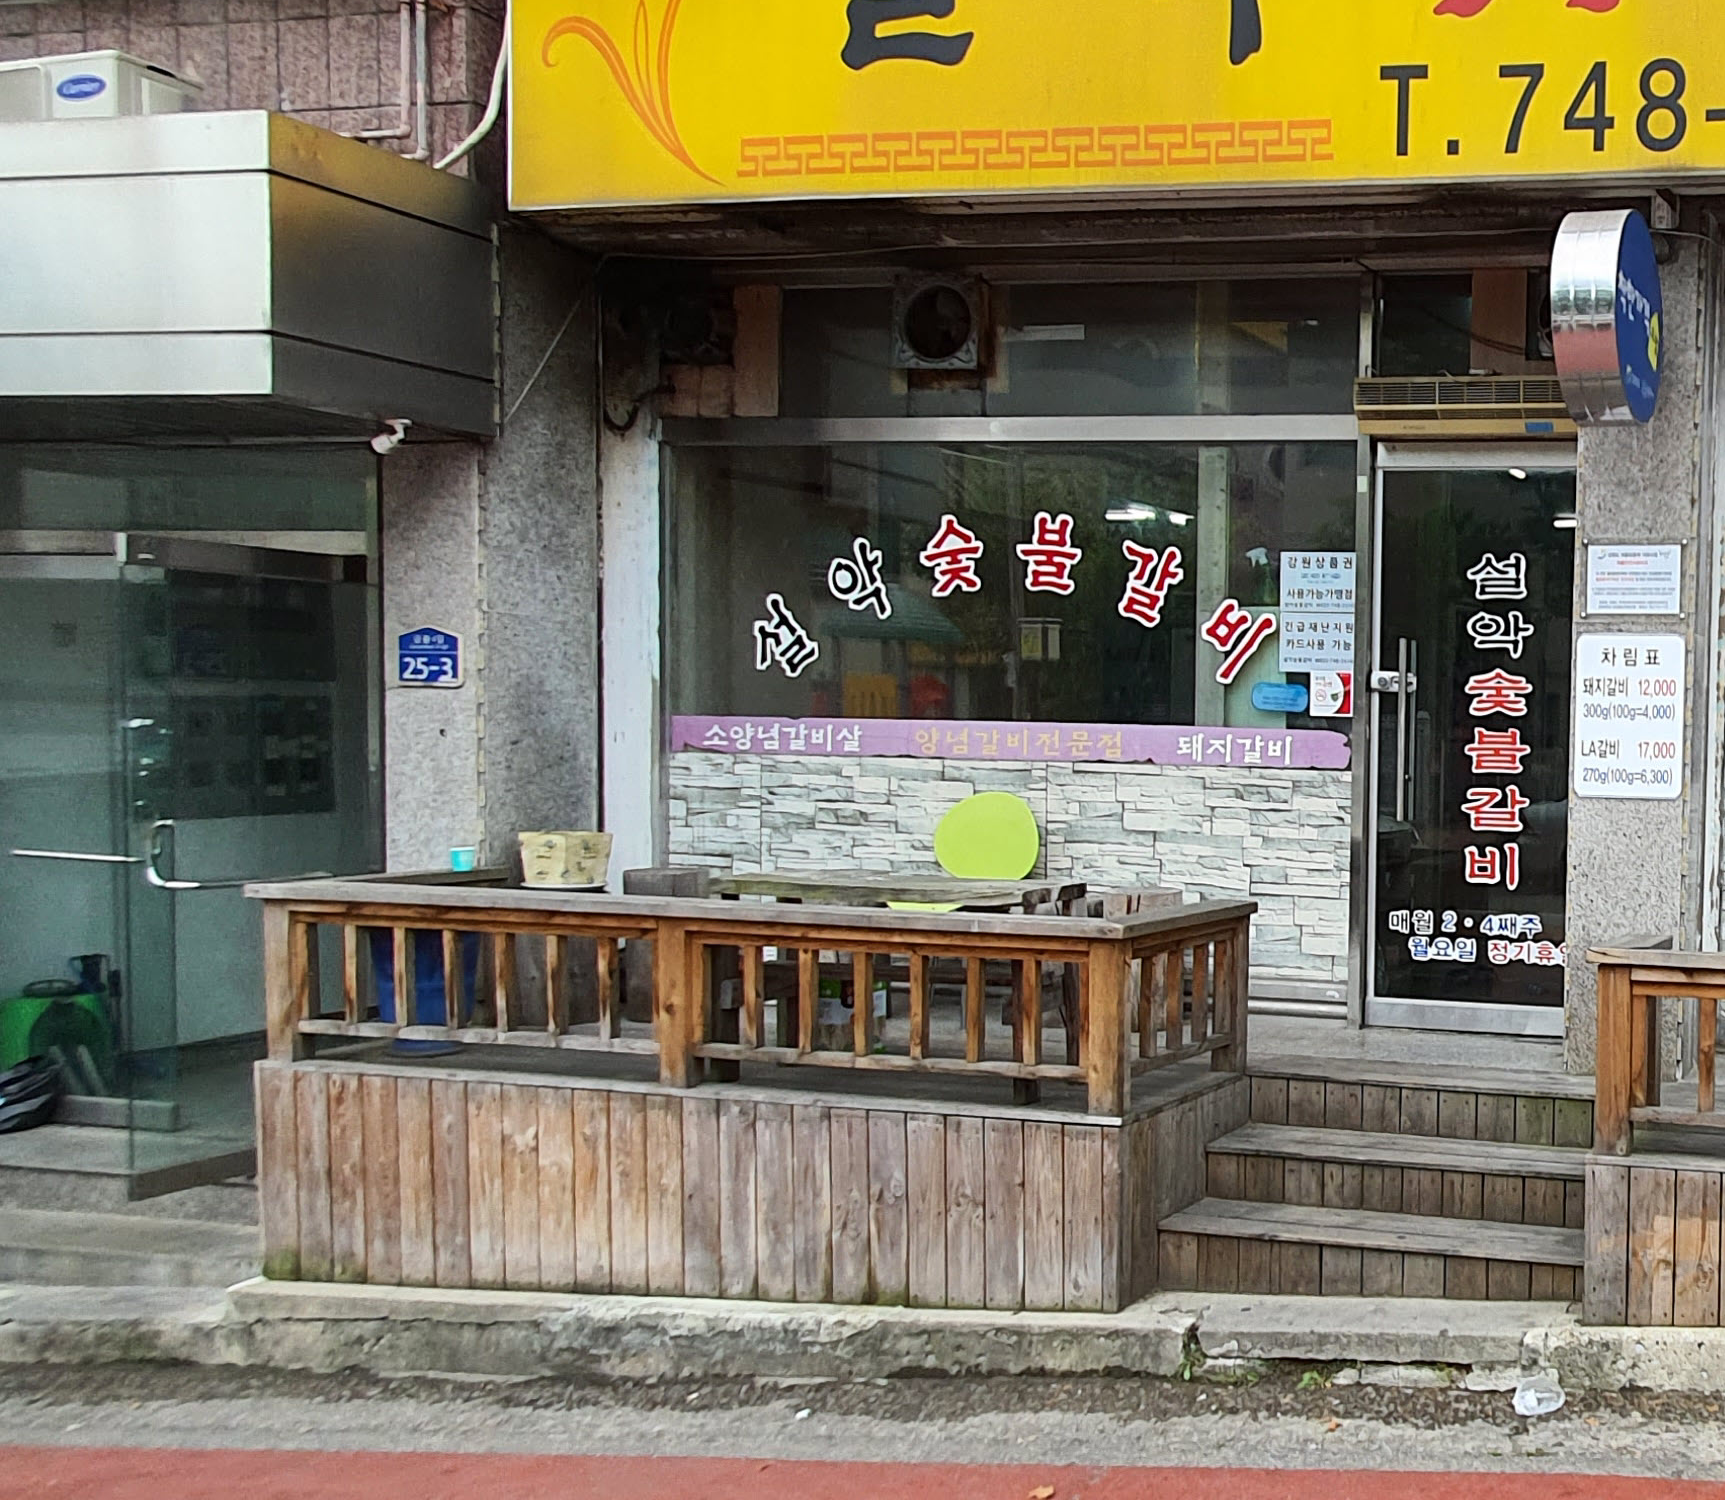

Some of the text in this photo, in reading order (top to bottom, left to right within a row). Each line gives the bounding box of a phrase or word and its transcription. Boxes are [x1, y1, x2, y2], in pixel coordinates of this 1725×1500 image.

[1600, 647, 1661, 668] 차림표
[402, 656, 454, 681] 25-3
[1582, 677, 1677, 697] 돼지갈비 12,000
[1583, 702, 1676, 721] 300g(100g=4,000)
[702, 721, 1294, 766] 소양념갈비살 양념갈비전문점 돼지갈비
[1581, 739, 1676, 760] LA갈비 17,000
[1582, 767, 1673, 786] 270g(100g=6,300)
[1389, 910, 1434, 934] 매월
[1408, 937, 1567, 967] 월요일 정기휴
